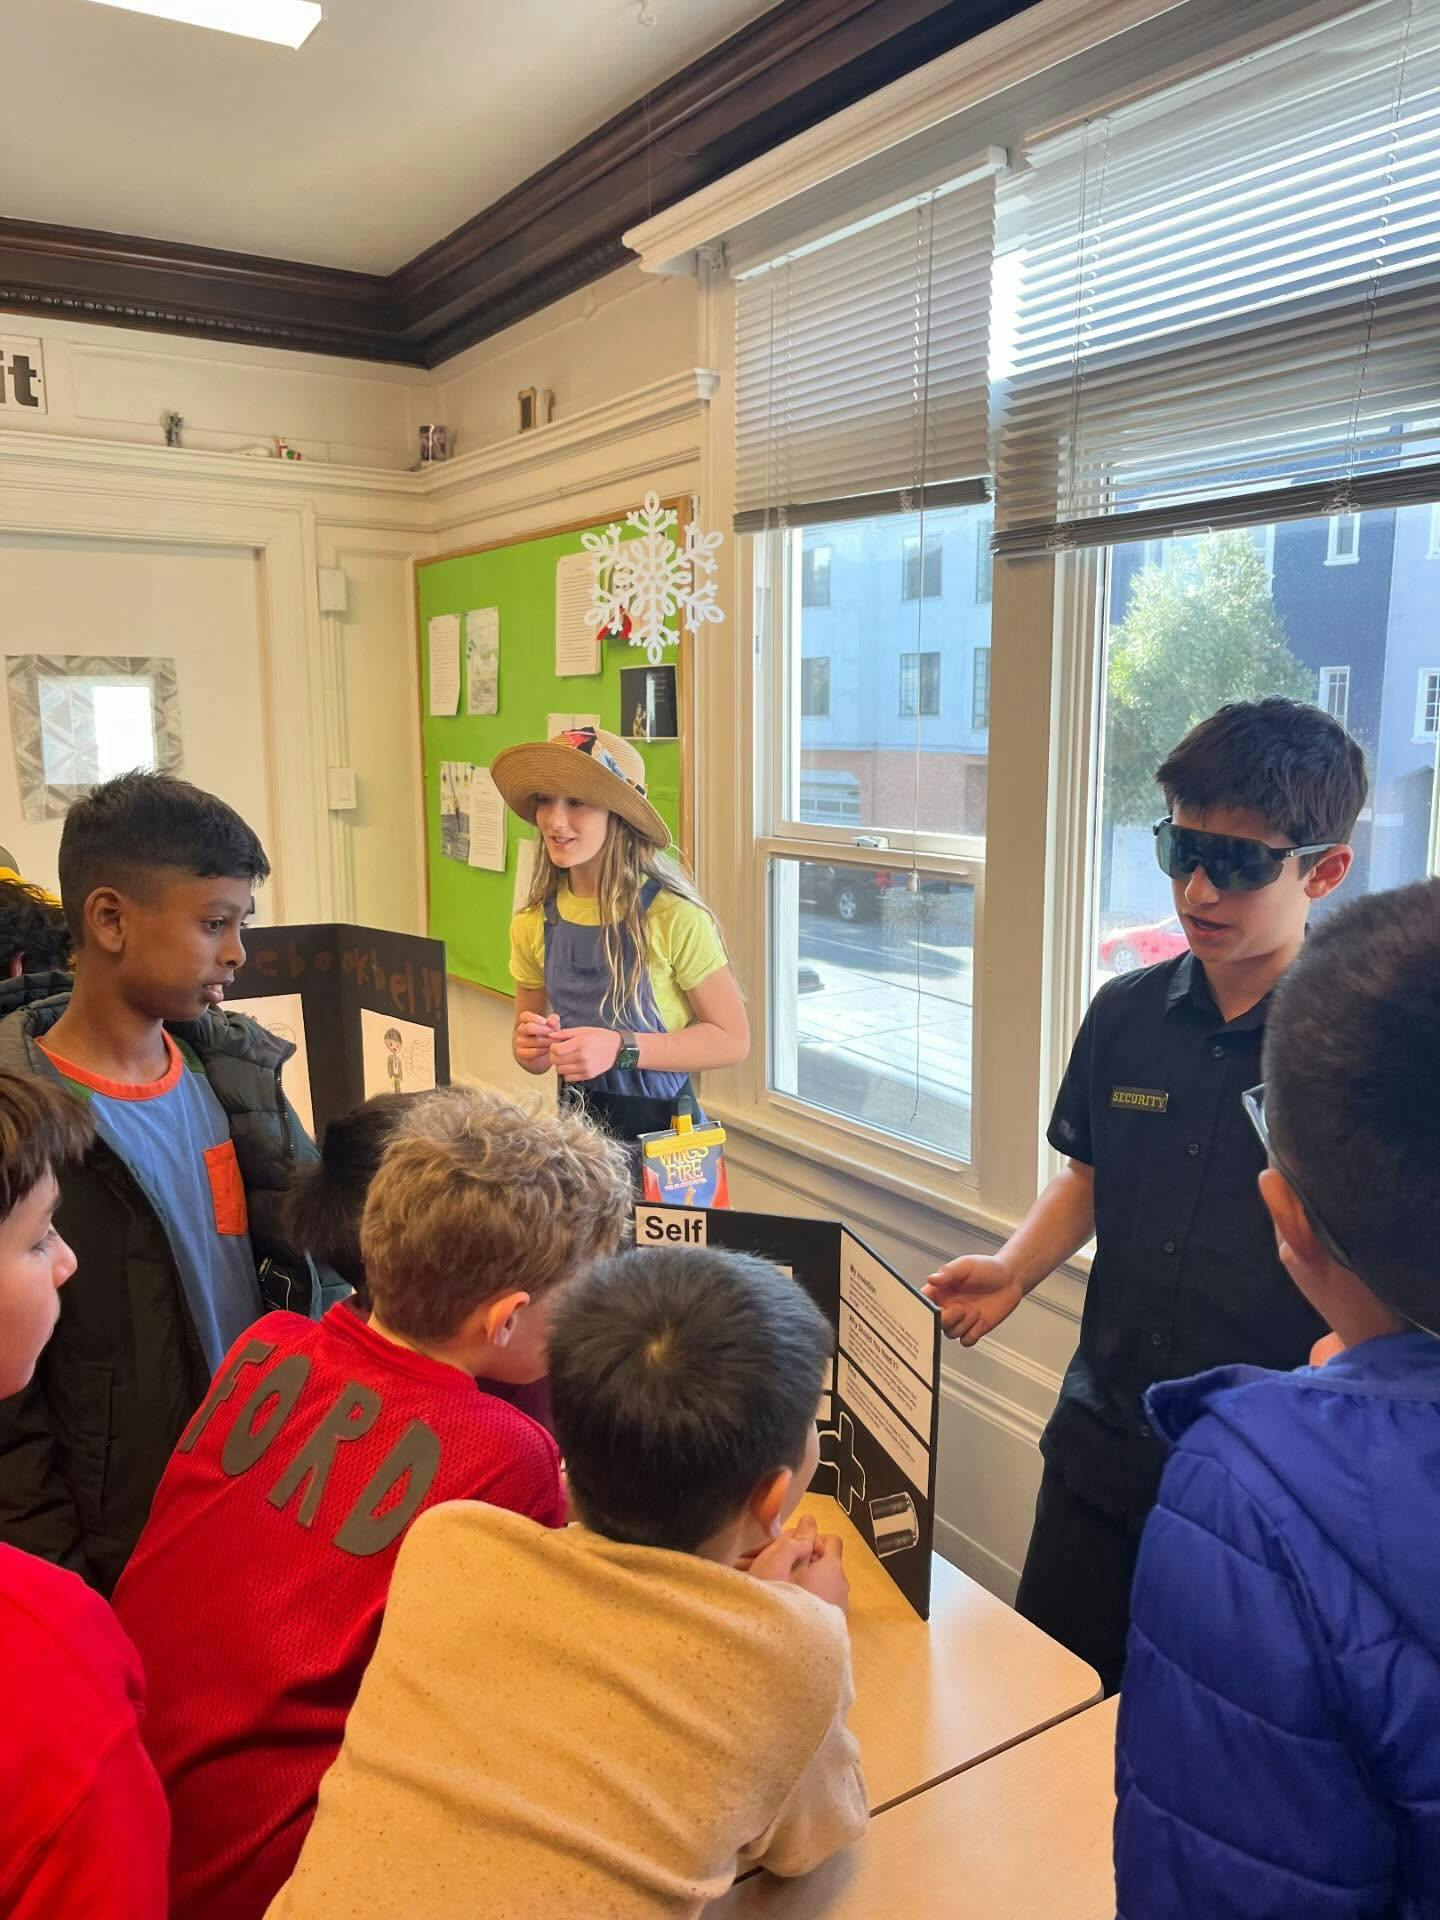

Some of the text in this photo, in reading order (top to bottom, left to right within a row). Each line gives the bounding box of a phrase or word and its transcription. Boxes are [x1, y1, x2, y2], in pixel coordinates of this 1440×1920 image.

[1112, 1090, 1167, 1109] SECURITY
[664, 1158, 705, 1185] FIRE
[644, 1214, 704, 1244] Self
[178, 1338, 442, 1557] FORD
